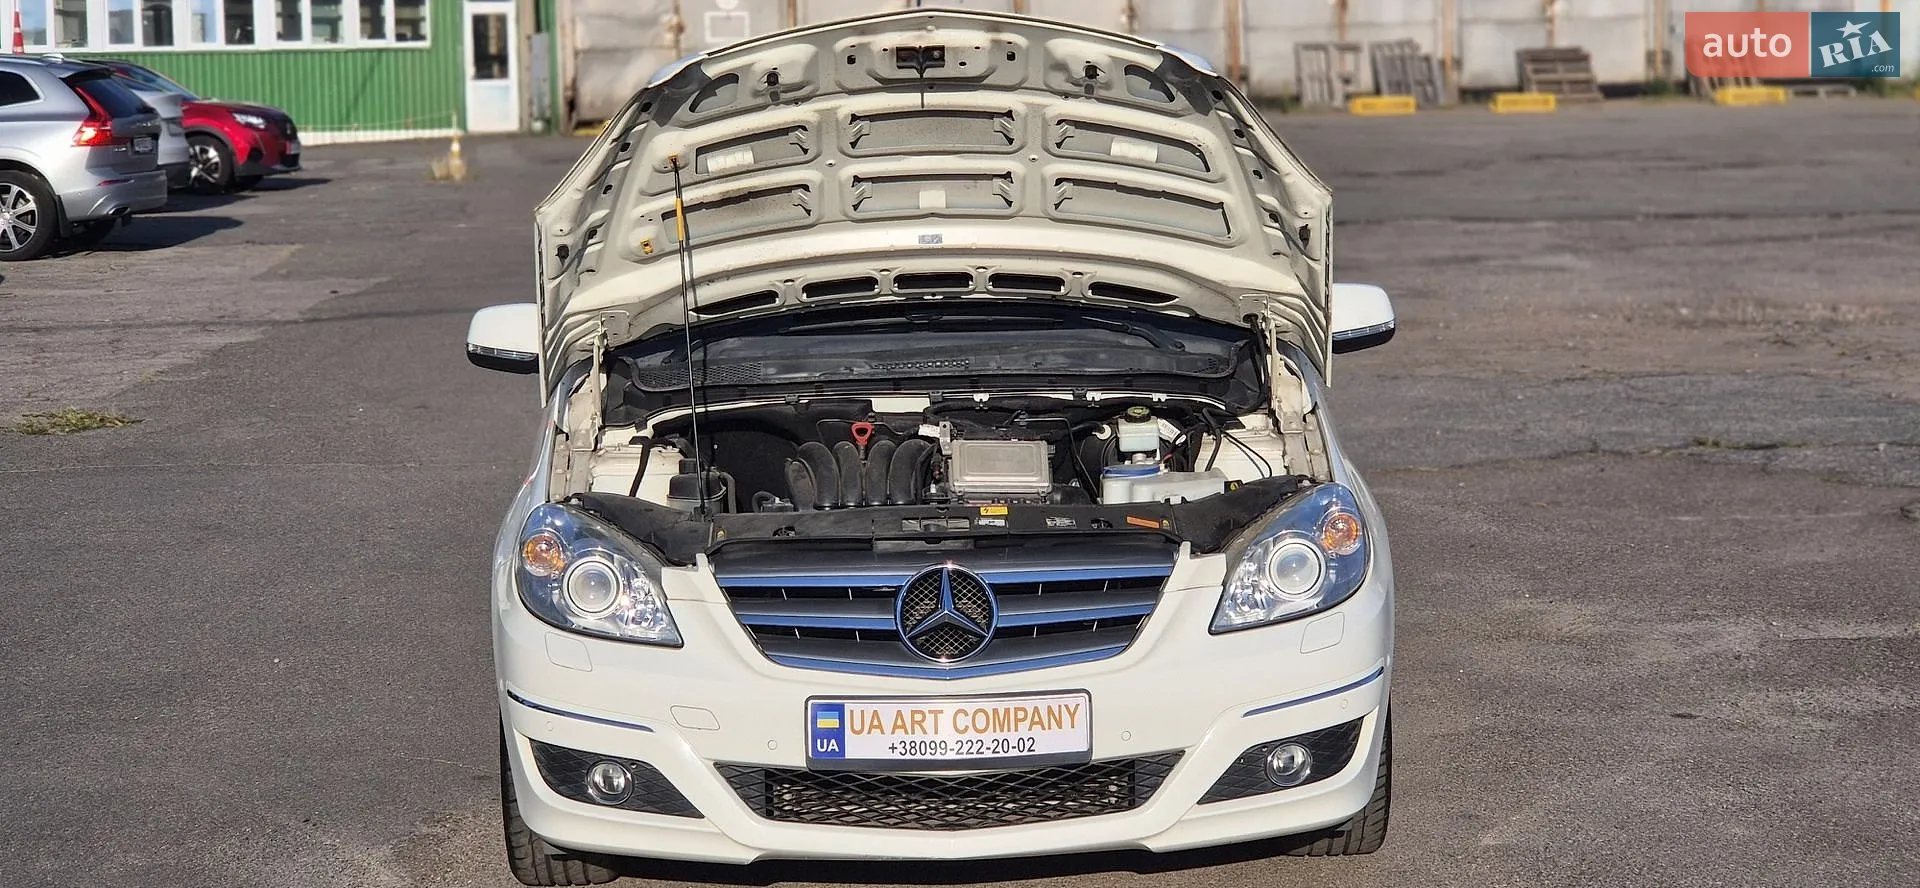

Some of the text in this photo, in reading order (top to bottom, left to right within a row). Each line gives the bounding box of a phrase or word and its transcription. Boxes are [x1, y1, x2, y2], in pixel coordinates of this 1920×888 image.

[849, 703, 1080, 735] UA ART COMPANY
[817, 738, 839, 752] UA
[888, 736, 1036, 757] +38099-222-20-02
